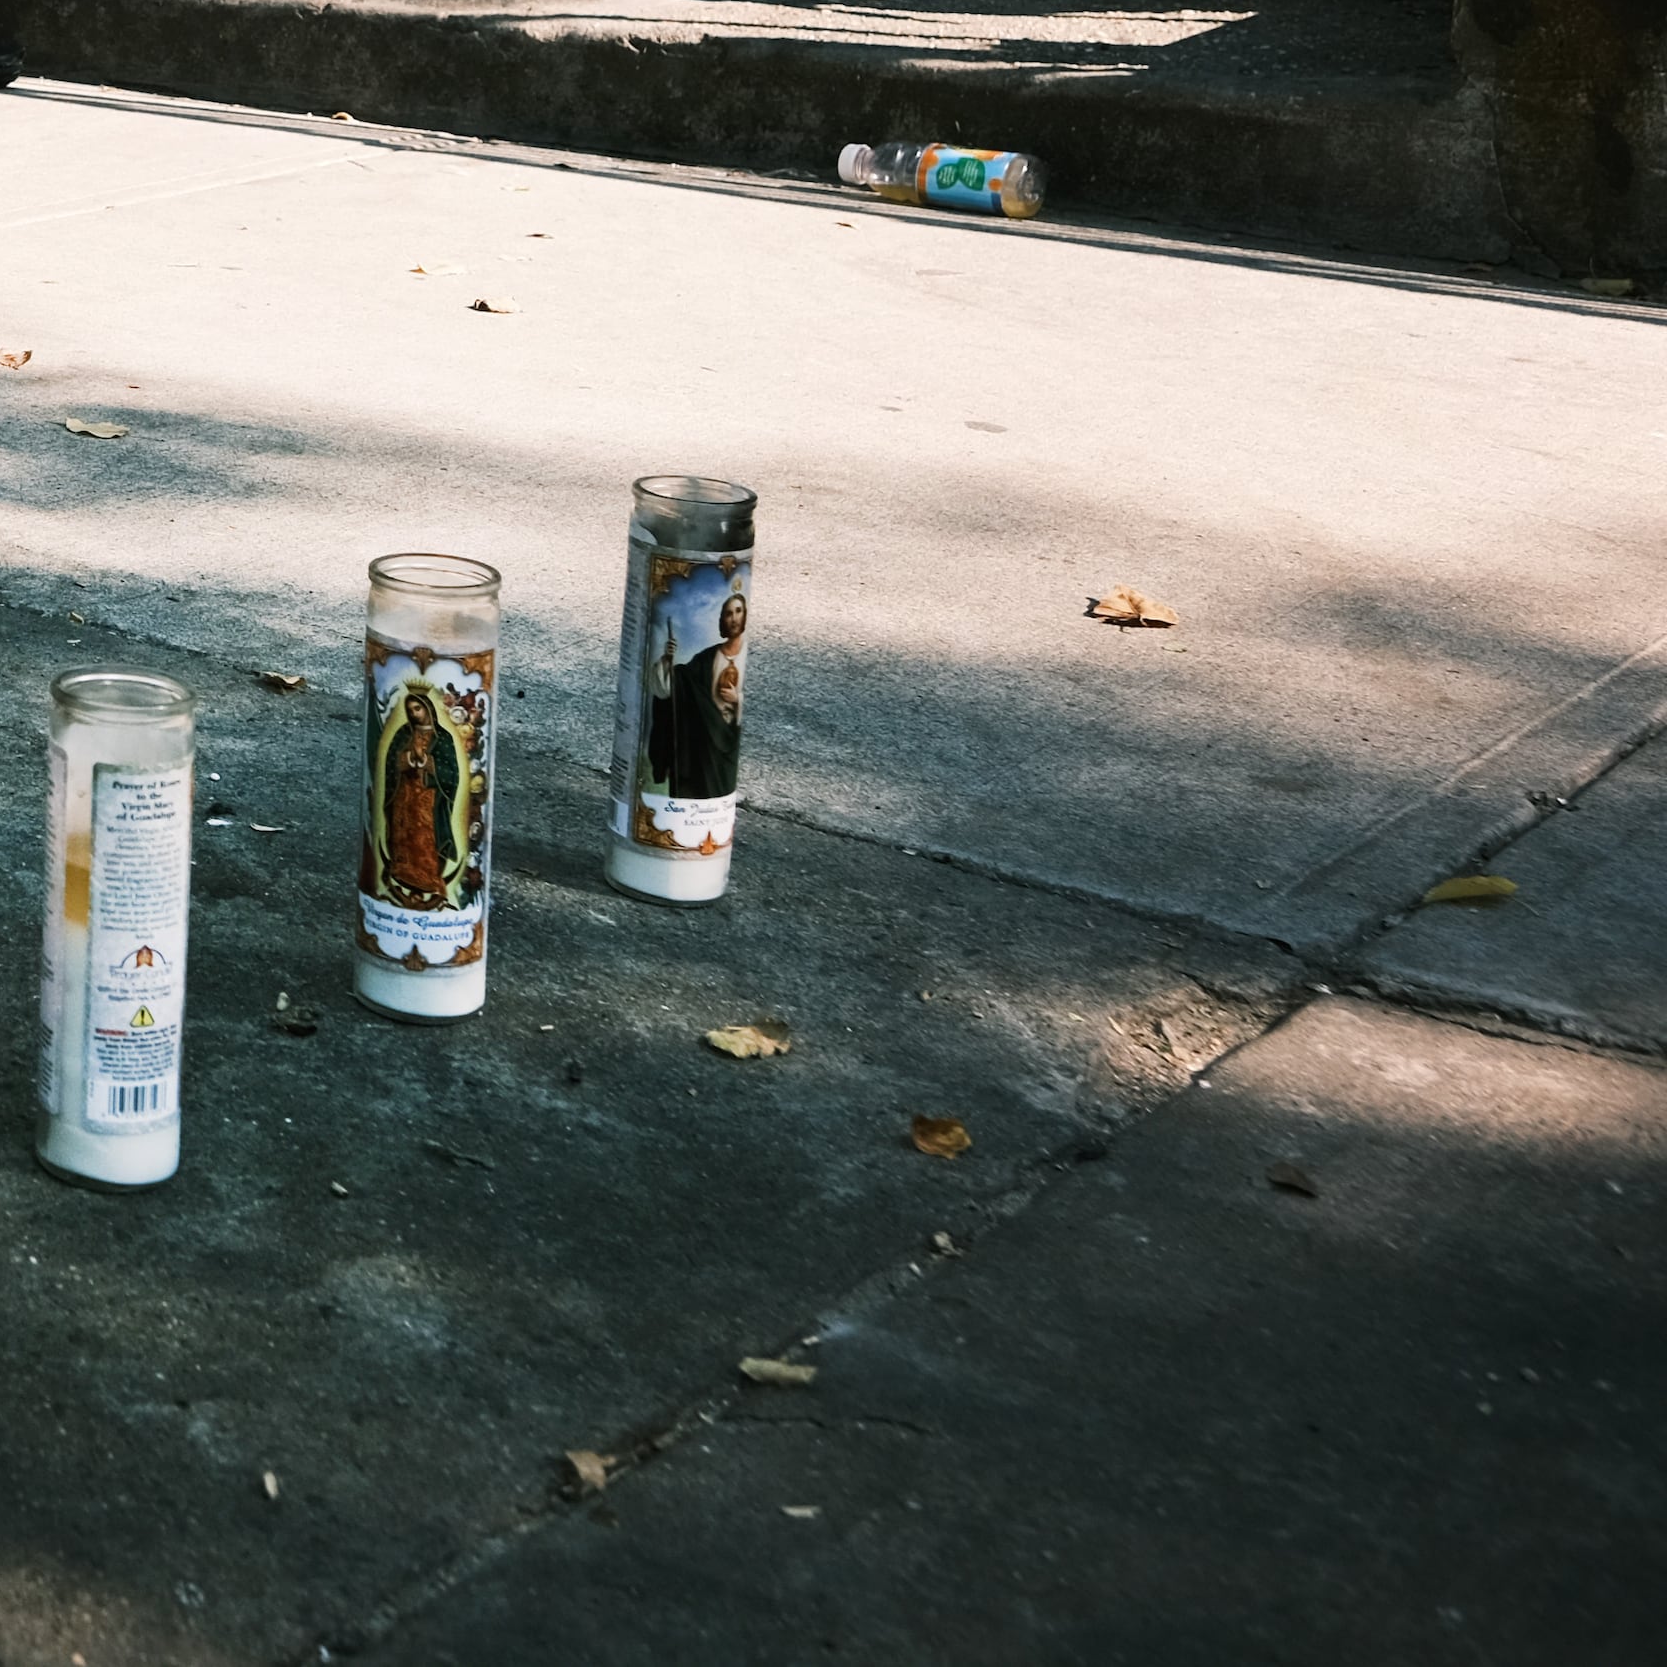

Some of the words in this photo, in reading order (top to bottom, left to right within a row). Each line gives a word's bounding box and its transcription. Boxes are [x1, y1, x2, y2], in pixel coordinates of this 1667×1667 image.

[112, 780, 144, 792] Prayer
[147, 781, 157, 790] of
[149, 791, 163, 800] the
[121, 802, 151, 811] Virgin
[664, 800, 686, 813] San
[115, 812, 127, 821] of
[131, 812, 176, 822] Guadalupe
[397, 914, 409, 925] de
[412, 916, 473, 931] Guadalupe
[365, 918, 393, 935] VIRGIN
[395, 929, 409, 938] OF
[412, 932, 470, 942] GUADALUPE
